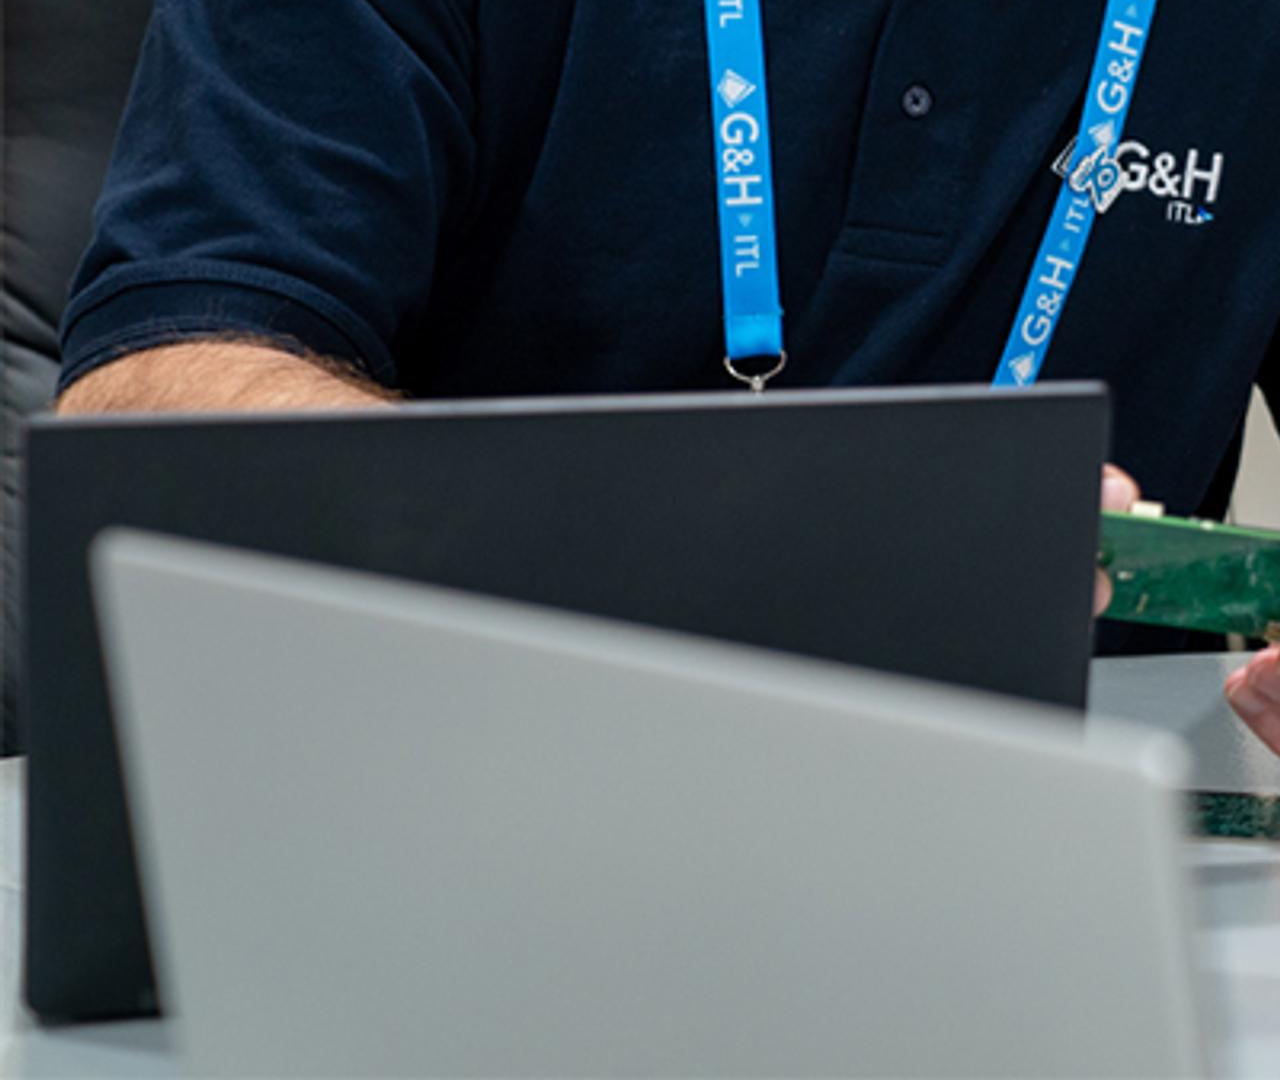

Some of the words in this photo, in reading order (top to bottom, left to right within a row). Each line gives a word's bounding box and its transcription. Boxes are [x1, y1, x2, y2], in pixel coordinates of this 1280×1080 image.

[1097, 20, 1144, 113] G&H
[720, 111, 763, 206] G&H
[1116, 139, 1224, 203] G&H
[733, 234, 760, 278] ITL
[1021, 254, 1074, 346] G&H
[1064, 197, 1090, 234] ITL
